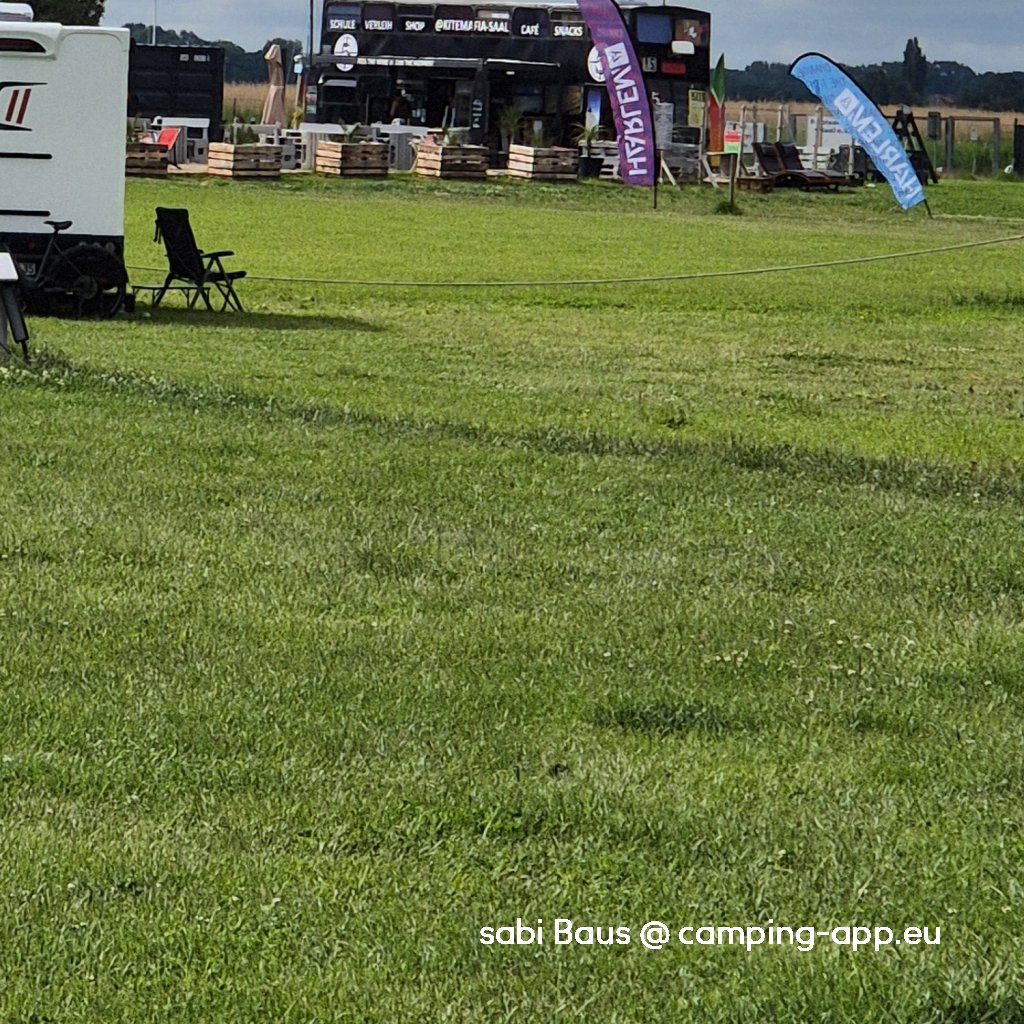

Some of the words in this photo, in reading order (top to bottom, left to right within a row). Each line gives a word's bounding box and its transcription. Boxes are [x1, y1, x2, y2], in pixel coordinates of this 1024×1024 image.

[329, 19, 356, 30] SCHULE
[364, 20, 393, 30] VERLEIH
[404, 21, 426, 31] SHOP
[520, 23, 540, 35] CAFÉ
[553, 26, 584, 36] SNACKS
